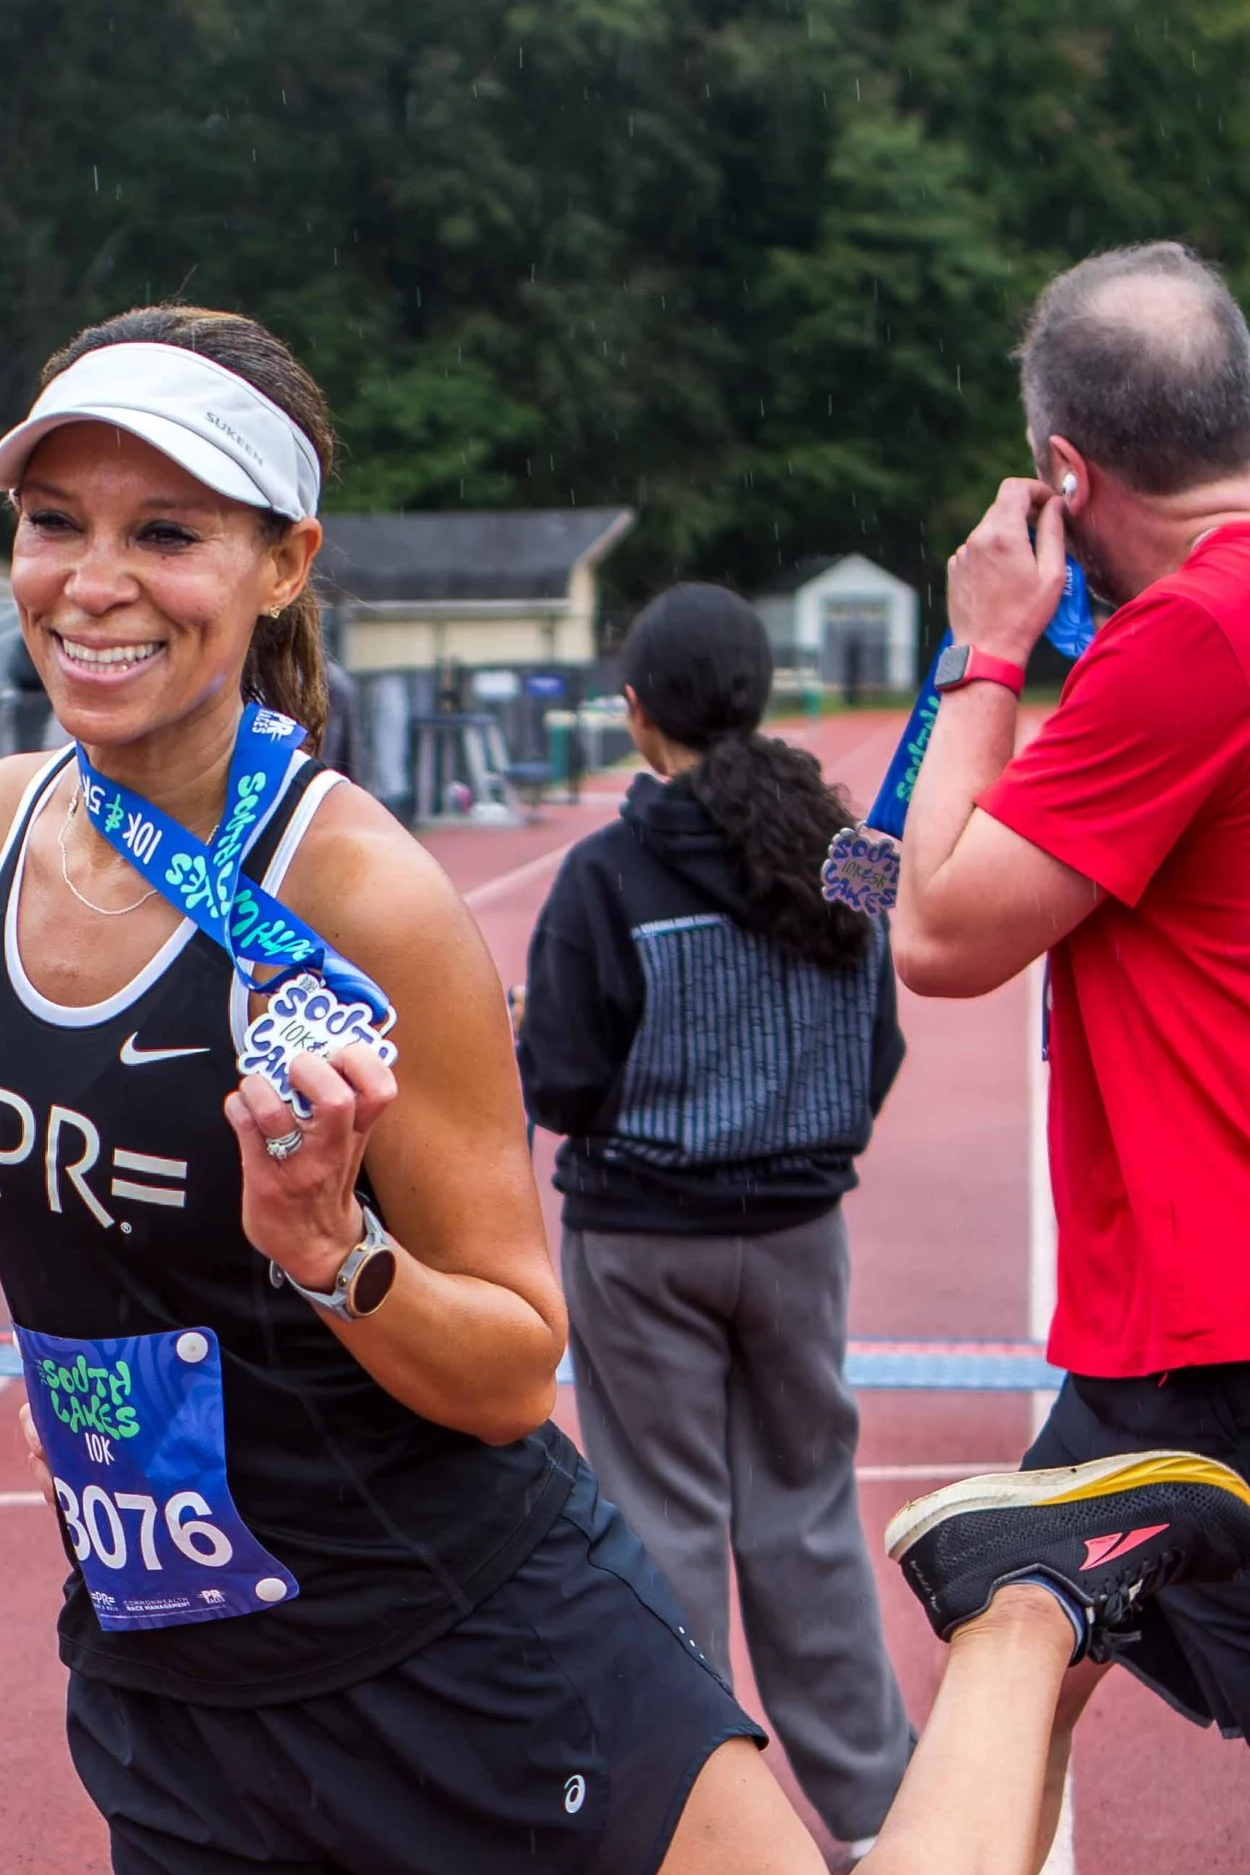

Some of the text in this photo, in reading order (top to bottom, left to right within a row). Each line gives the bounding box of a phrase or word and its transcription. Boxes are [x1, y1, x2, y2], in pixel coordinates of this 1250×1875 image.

[82, 773, 106, 815] 5K
[213, 771, 267, 868] SOUTH
[122, 812, 162, 865] 10K
[274, 987, 389, 1059] SOUT
[42, 1355, 131, 1406] SOUTH
[50, 1390, 141, 1441] LAKES
[84, 1432, 115, 1466] 10K
